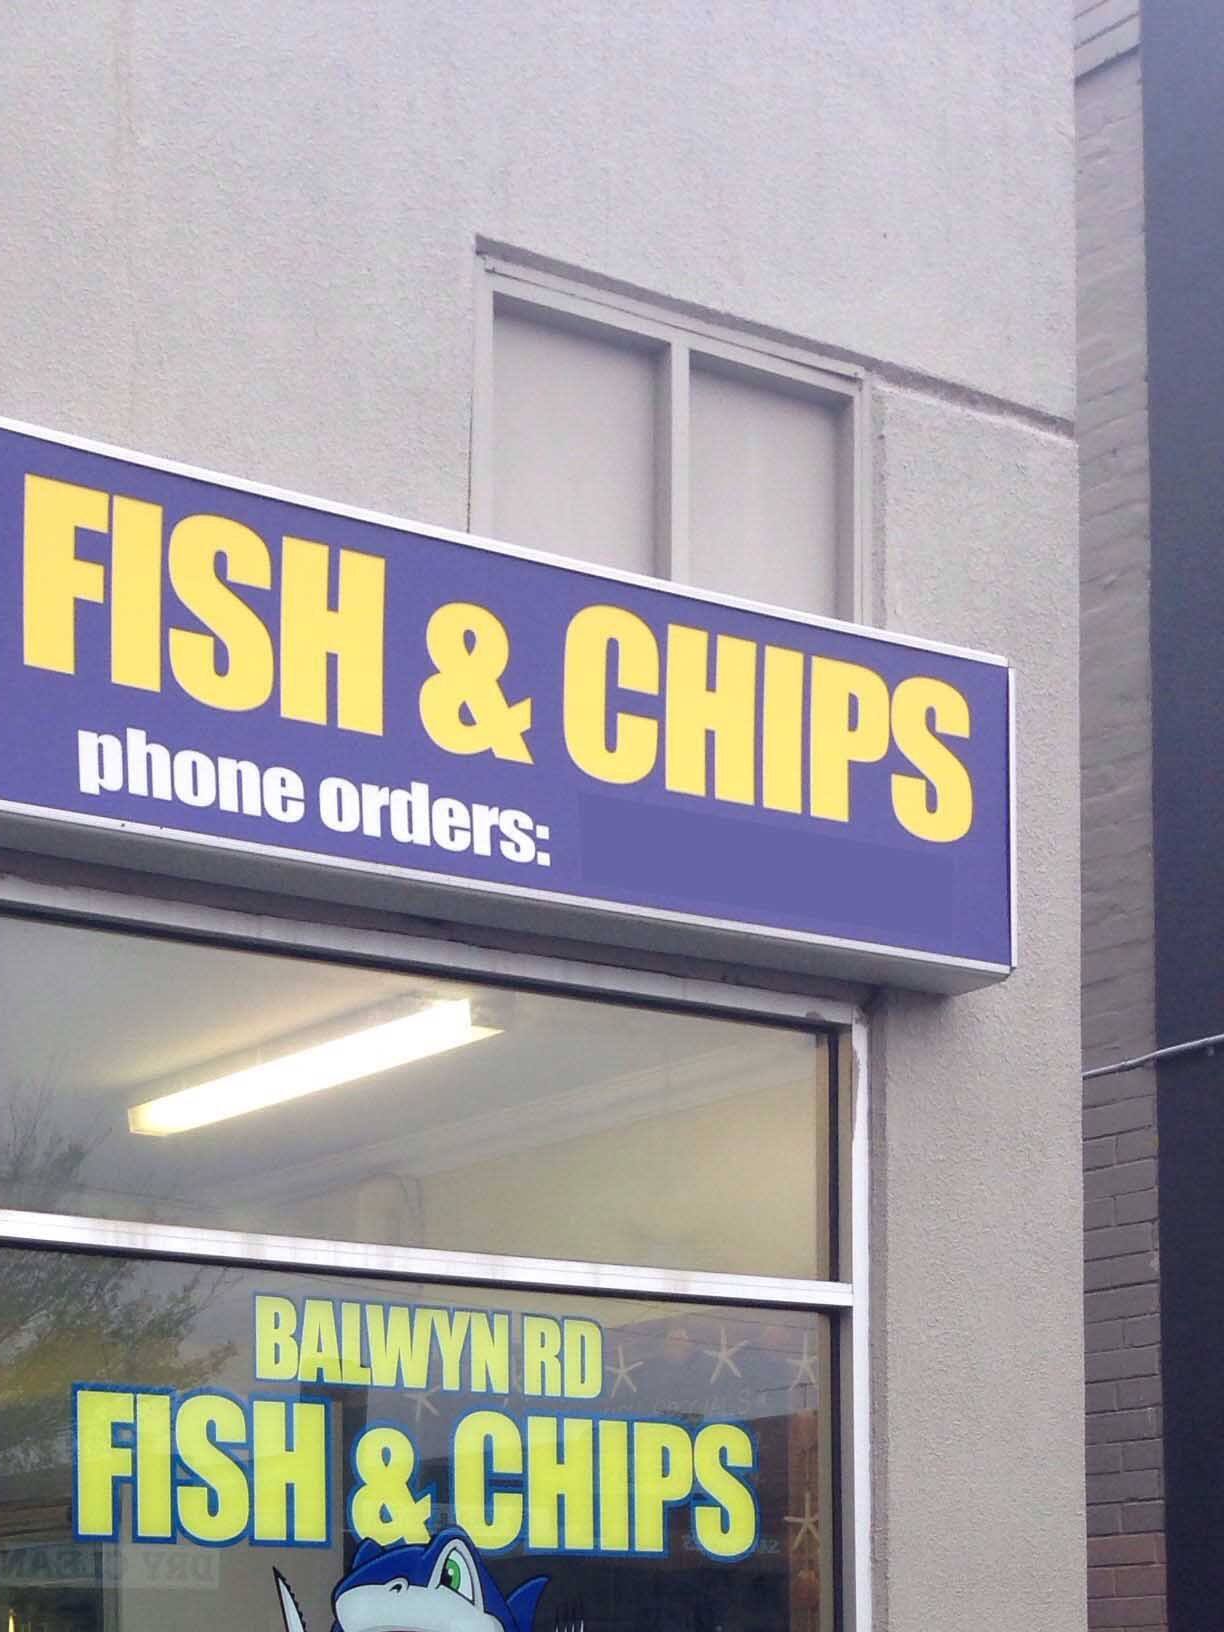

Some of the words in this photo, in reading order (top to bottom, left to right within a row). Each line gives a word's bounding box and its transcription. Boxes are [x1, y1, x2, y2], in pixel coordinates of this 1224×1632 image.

[23, 473, 386, 735] FISH
[419, 601, 533, 765] &
[563, 605, 974, 843] CHIPS
[77, 727, 305, 819] phone
[318, 776, 552, 867] orders:
[256, 1295, 510, 1391] BALWYN
[523, 1315, 604, 1398] RD
[77, 1389, 327, 1541] FISH
[353, 1428, 432, 1545] &
[453, 1410, 756, 1556] CHIPS
